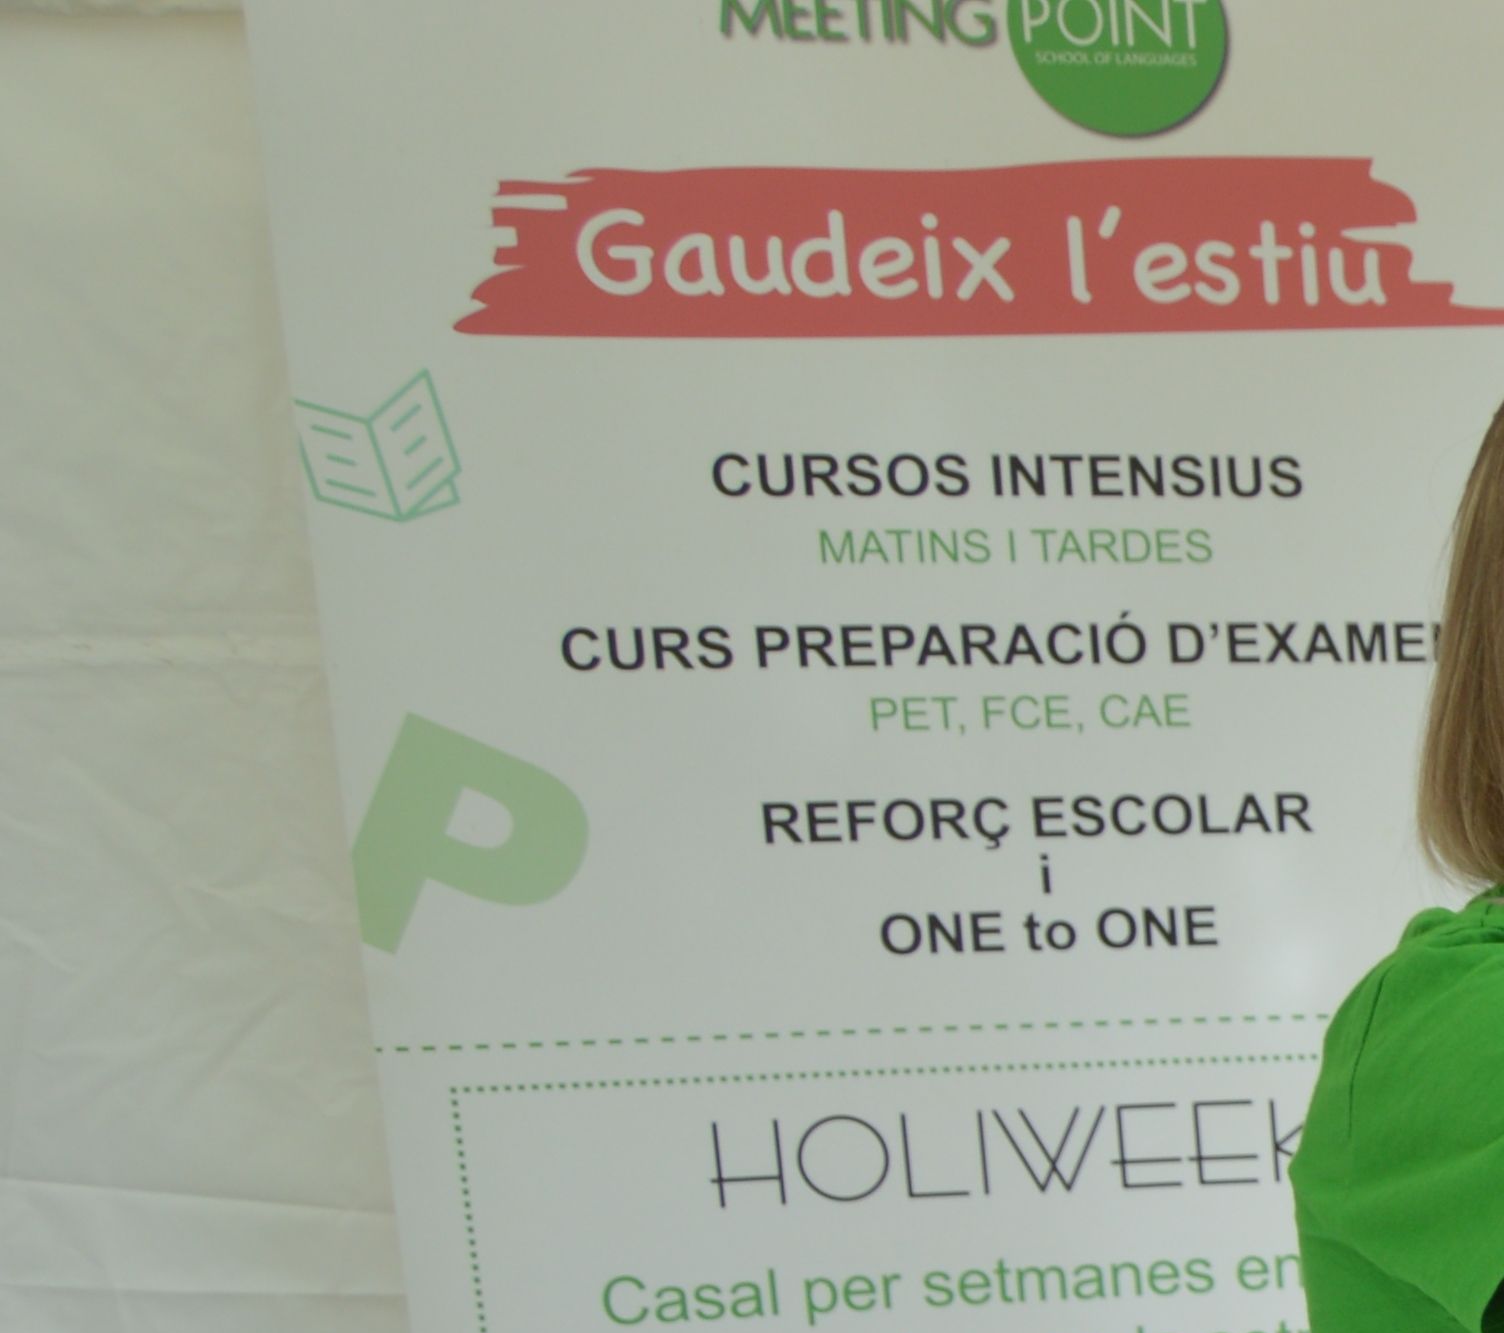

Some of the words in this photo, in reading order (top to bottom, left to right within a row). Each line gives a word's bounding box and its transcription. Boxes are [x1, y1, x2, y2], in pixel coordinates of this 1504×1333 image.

[1035, 50, 1091, 66] SCHOOL
[1094, 50, 1111, 66] OF
[1115, 50, 1197, 68] LANGUAGES
[576, 207, 1014, 303] Gaudeix
[712, 452, 970, 500] CURSOS
[992, 454, 1304, 500] INTENSIUS
[818, 528, 993, 567] MATINS
[1029, 528, 1213, 567] TARDES
[560, 626, 734, 672] CURS
[756, 611, 1148, 670] PREPARACIÓ
[869, 695, 966, 736] PET,
[980, 694, 1085, 735] FCE,
[1099, 694, 1191, 730] CAE
[762, 799, 1011, 849] REFORÇ
[1031, 792, 1312, 842] ESCOLAR
[1040, 853, 1053, 897] i
[880, 909, 1006, 957] ONE
[1022, 912, 1078, 952] to
[1096, 904, 1218, 950] ONE
[601, 1270, 780, 1327] Casal
[804, 1268, 900, 1323] per
[923, 1251, 1214, 1311] setmanes
